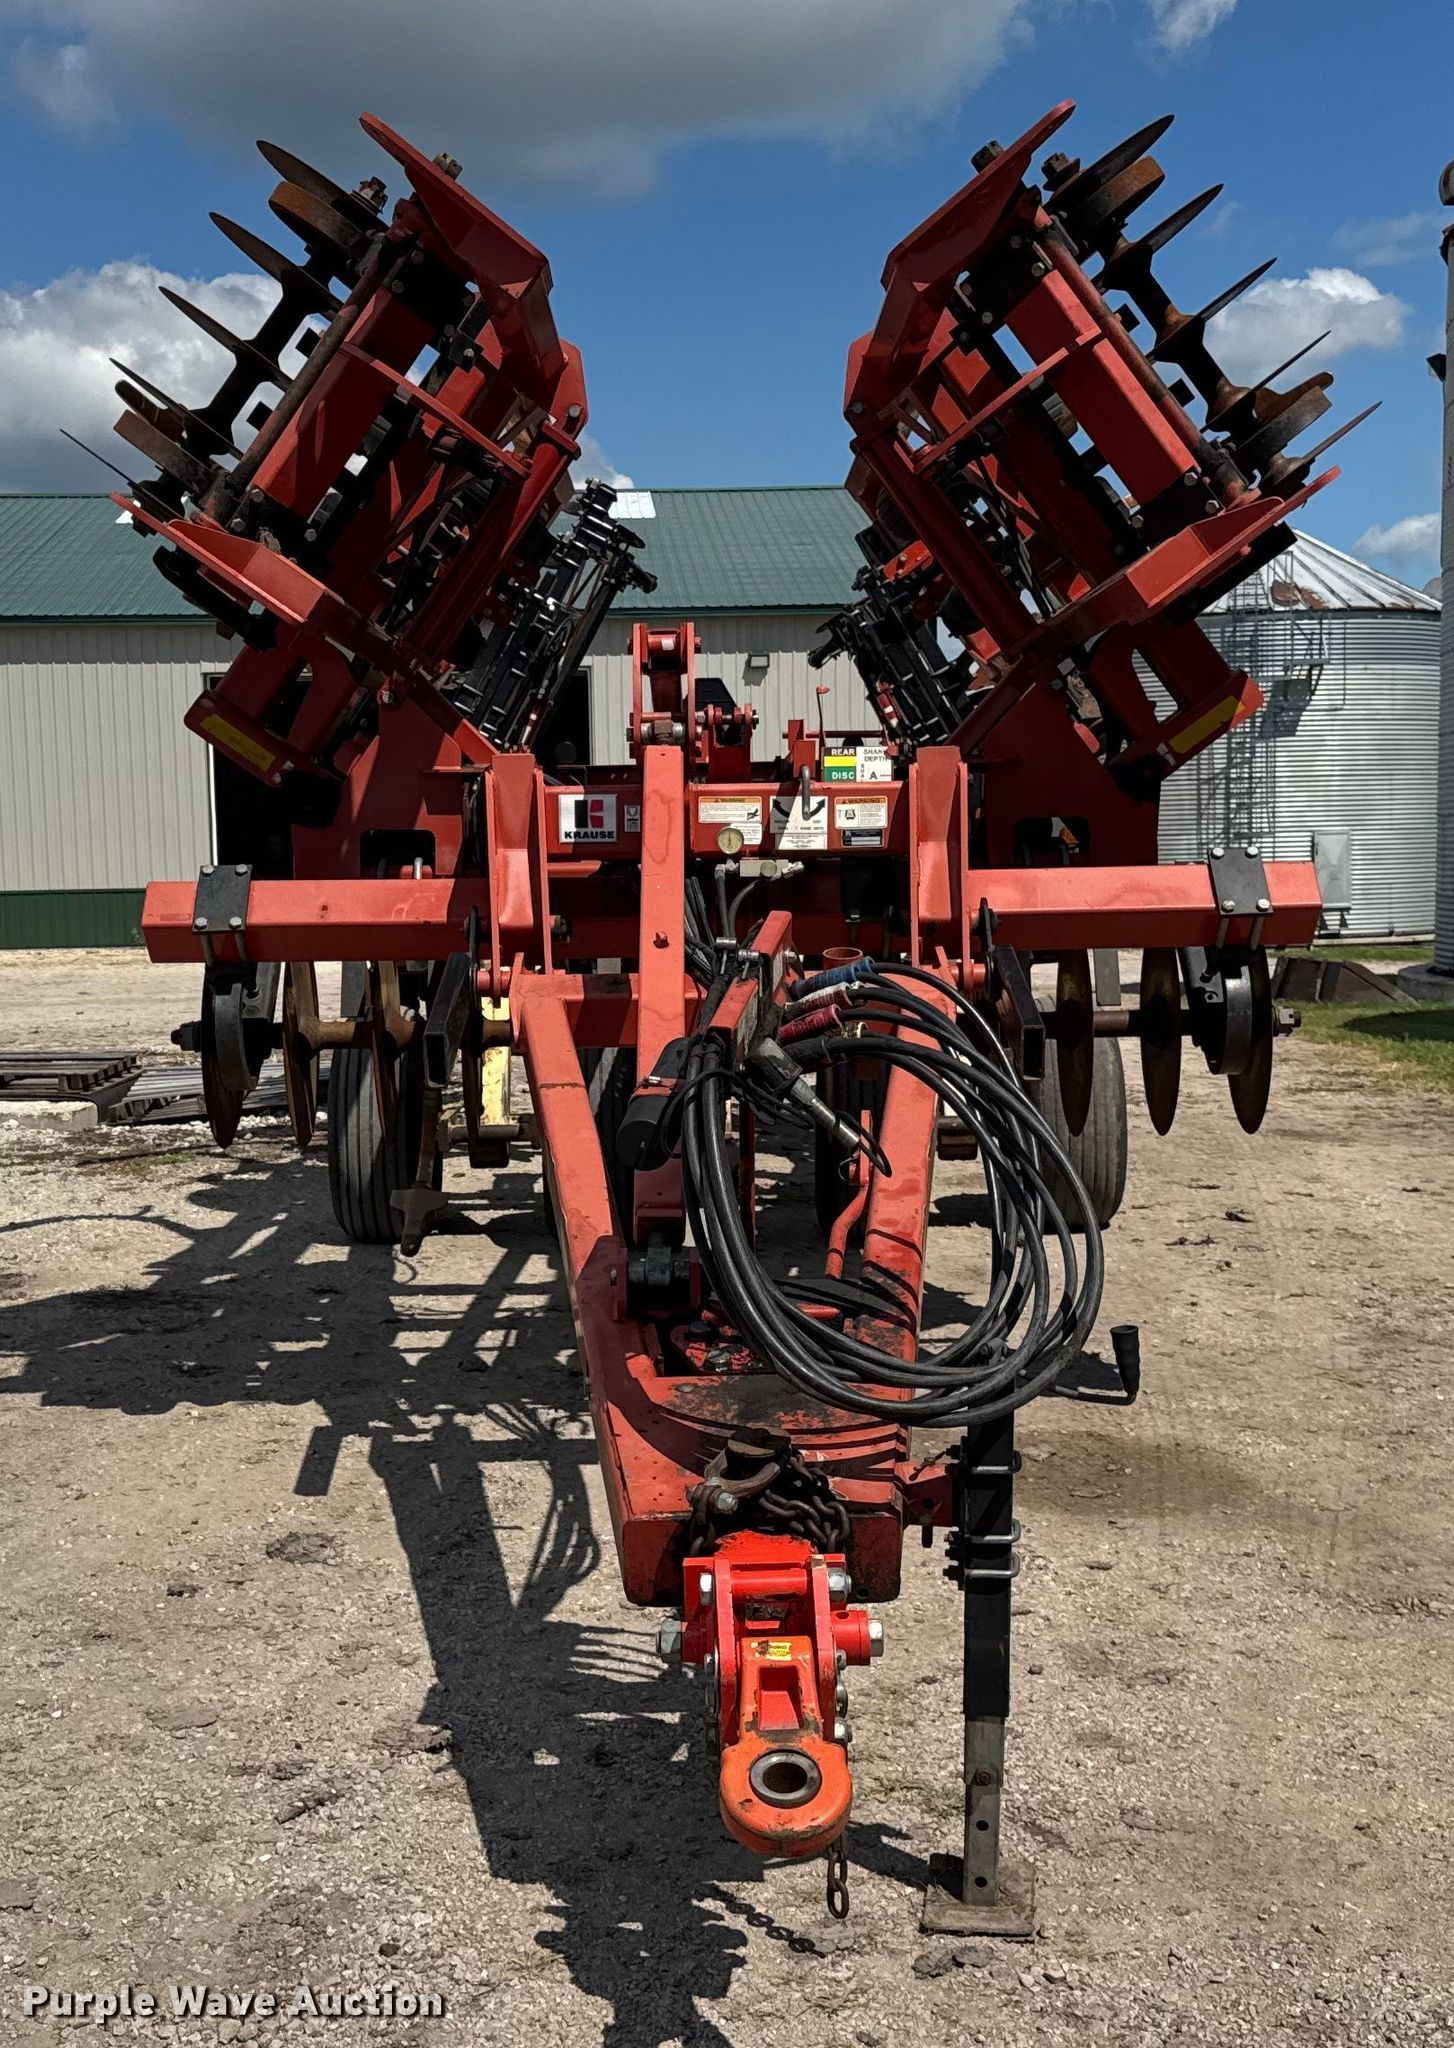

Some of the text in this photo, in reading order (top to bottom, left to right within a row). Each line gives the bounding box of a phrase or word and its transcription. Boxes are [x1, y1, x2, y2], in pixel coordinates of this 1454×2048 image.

[831, 748, 855, 756] REAR
[831, 771, 855, 780] DISC
[869, 771, 878, 780] A
[564, 831, 615, 839] KRAUSE
